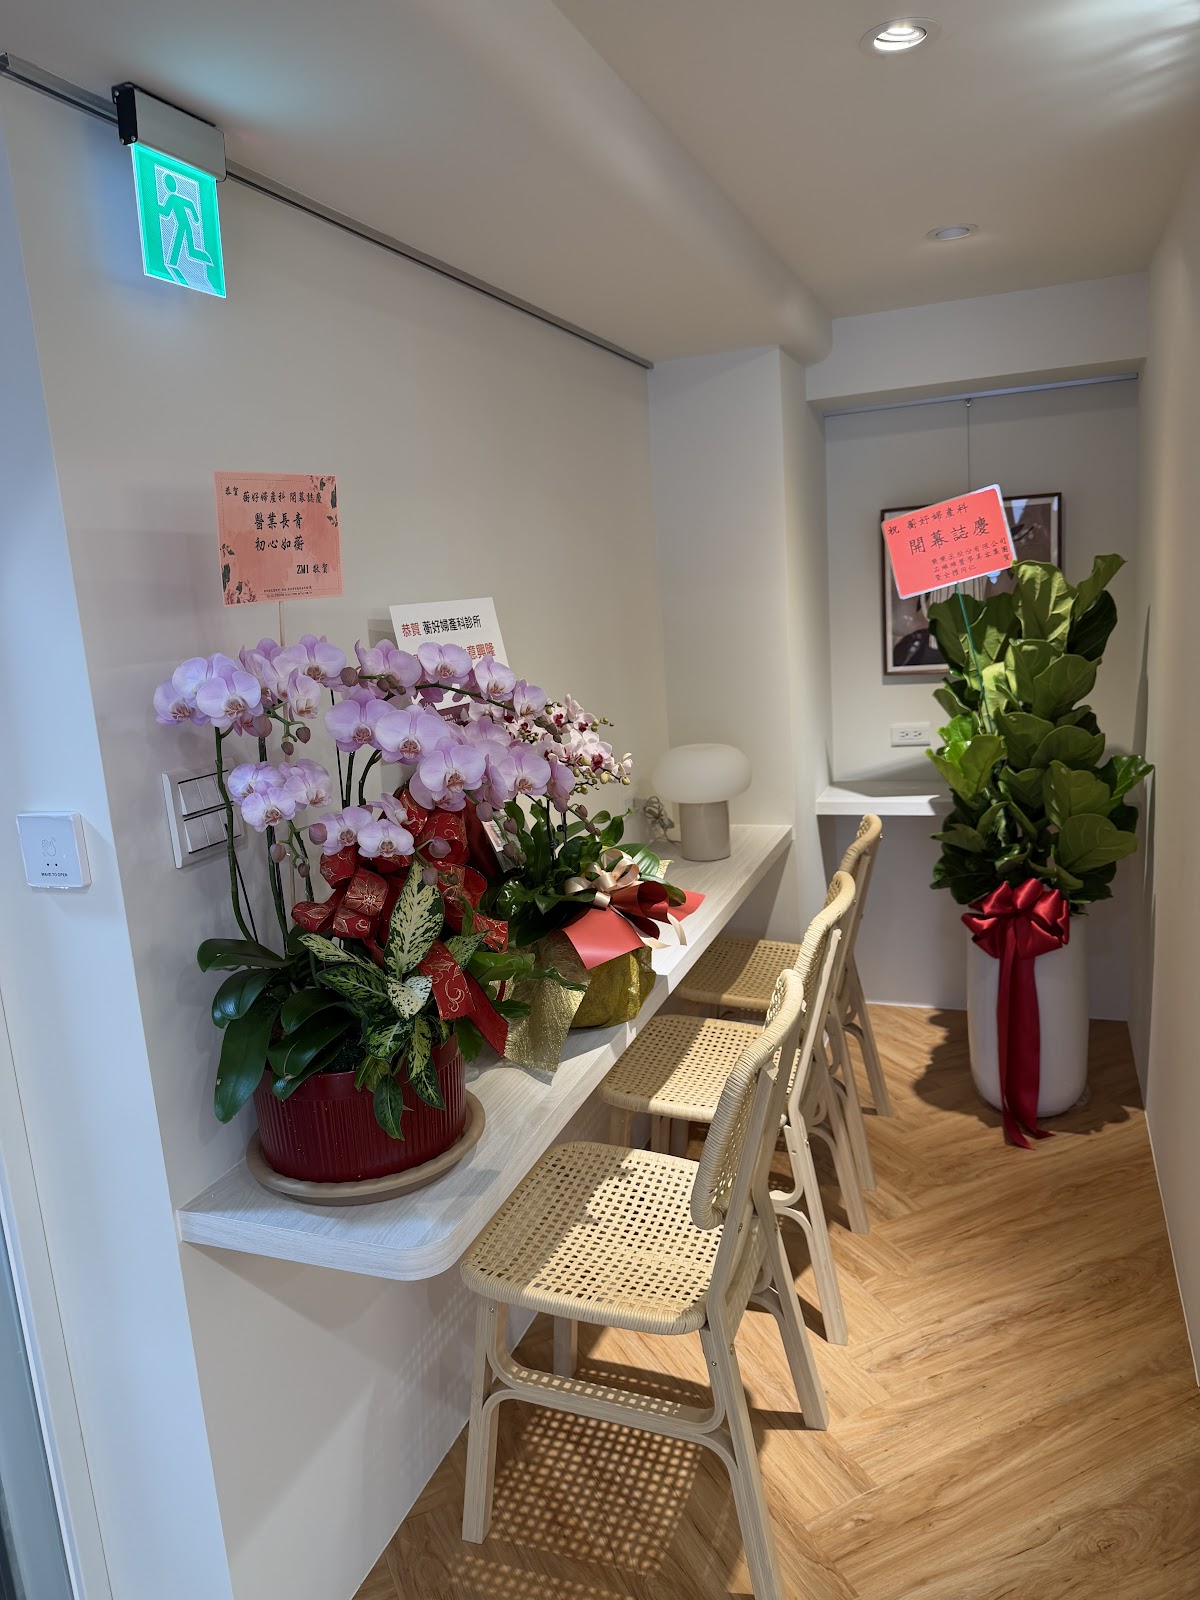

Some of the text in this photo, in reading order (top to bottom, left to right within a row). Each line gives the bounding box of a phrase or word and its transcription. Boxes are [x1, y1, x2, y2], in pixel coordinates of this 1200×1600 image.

[254, 511, 303, 531] 醫業長青
[888, 525, 900, 535] 祝
[909, 516, 990, 555] 開幕誌慶
[401, 622, 422, 638] 恭賀
[461, 642, 496, 660] 意興隆
